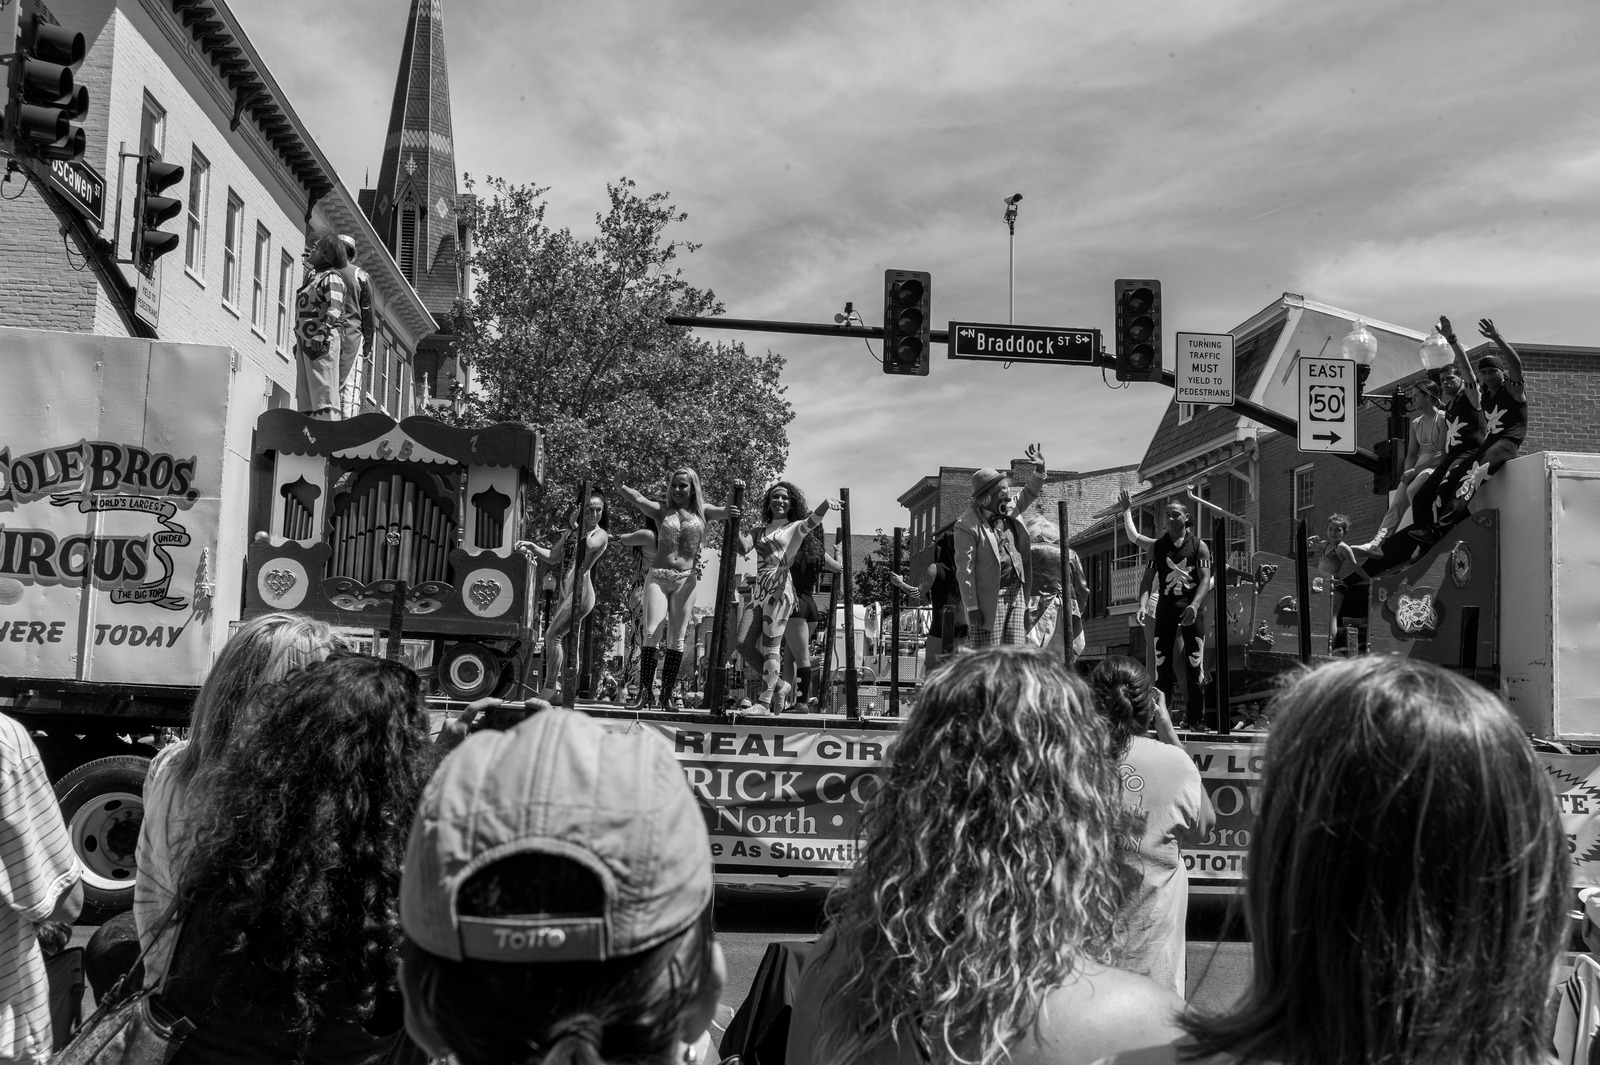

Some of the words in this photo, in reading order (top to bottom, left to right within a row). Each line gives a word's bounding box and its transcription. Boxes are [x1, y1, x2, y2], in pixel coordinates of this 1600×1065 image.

[977, 332, 1055, 355] Braddock
[1057, 336, 1070, 347] ST
[1189, 340, 1222, 349] TURNING
[1189, 351, 1221, 361] TRAFFIC
[1191, 363, 1219, 374] MUST
[1309, 364, 1346, 379] EAST
[1187, 376, 1211, 385] YIELD
[1213, 377, 1223, 386] TO
[1179, 387, 1231, 398] PEDESTRIANS
[1313, 393, 1341, 414] 50
[90, 443, 198, 502] BROS.
[90, 498, 127, 509] WORLD'S
[129, 498, 166, 513] LARGEST
[157, 534, 183, 544] UNDER
[0, 526, 148, 582] IRCUS
[117, 589, 132, 599] THE
[134, 590, 148, 599] BIG
[95, 624, 184, 648] TODAY
[675, 730, 798, 758] REAL
[816, 740, 893, 761] CIR
[684, 767, 805, 803] RICK
[713, 805, 818, 835] North
[731, 841, 762, 858] As
